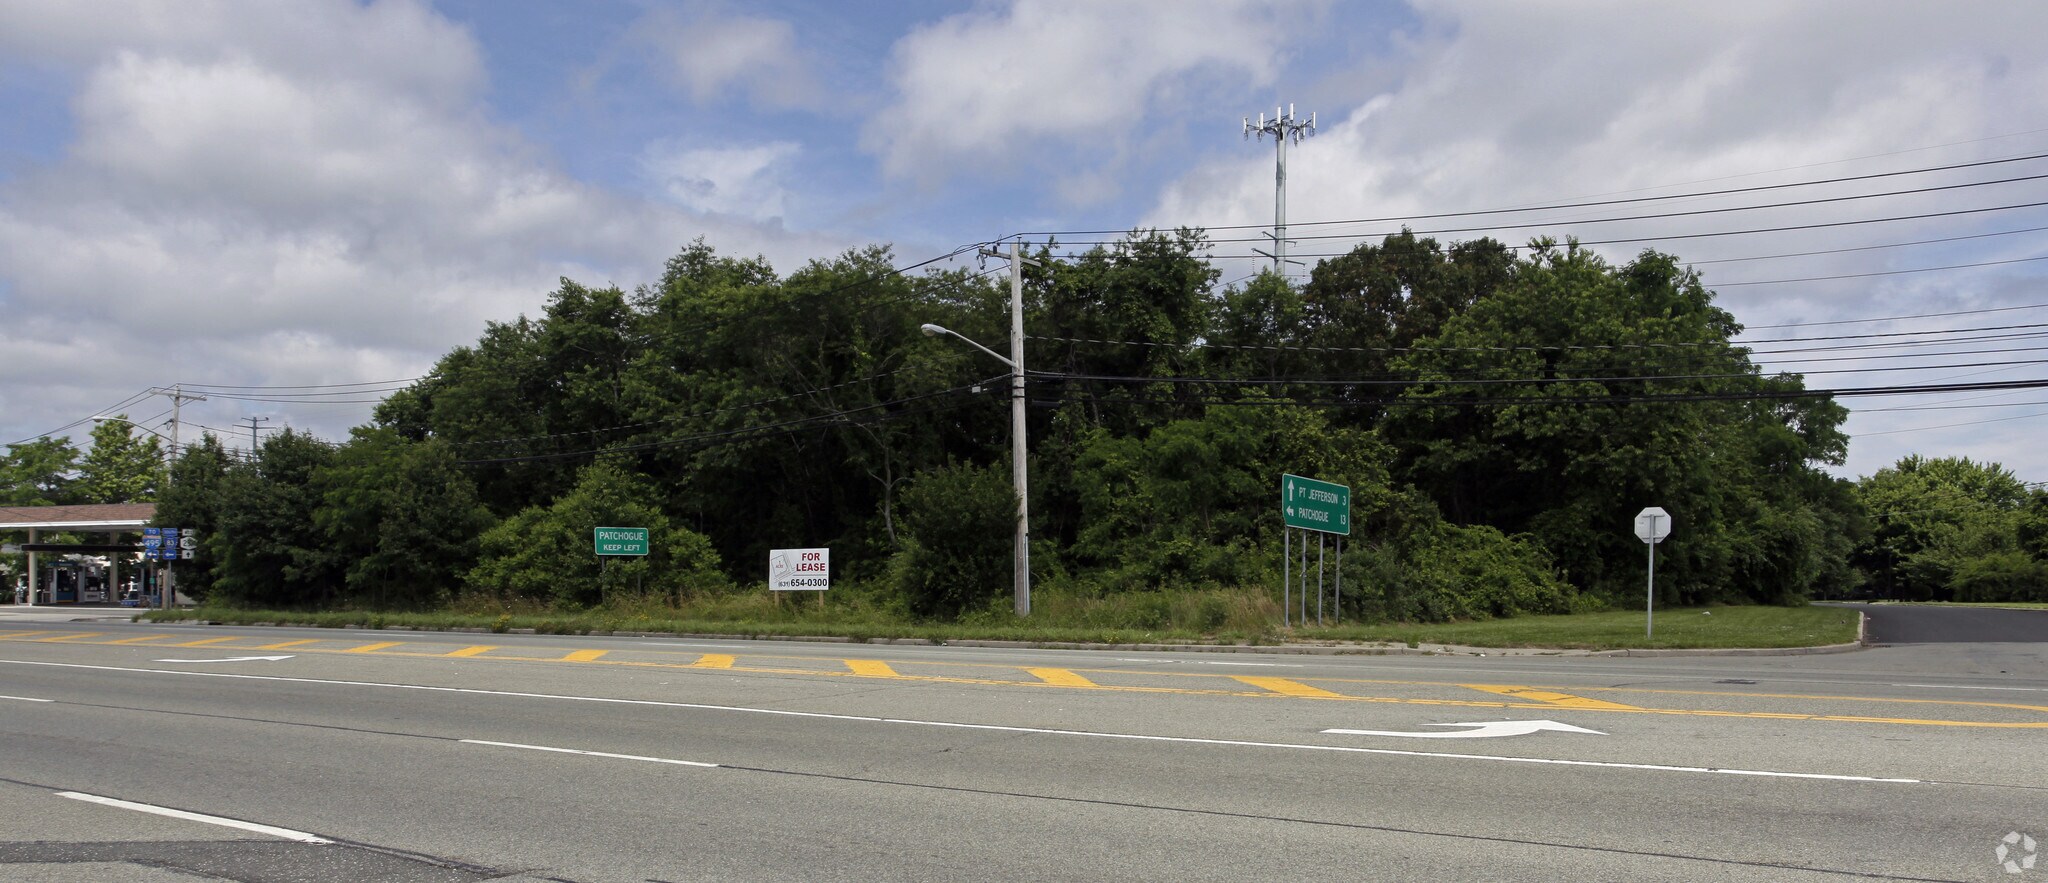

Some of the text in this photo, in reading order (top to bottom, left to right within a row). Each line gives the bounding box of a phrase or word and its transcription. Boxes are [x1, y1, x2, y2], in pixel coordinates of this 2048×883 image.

[1298, 486, 1347, 506] PT JEFFERSON 3
[1298, 507, 1347, 525] PATCHOGUE 13
[599, 531, 644, 541] PATCHOGUE
[144, 539, 160, 547] 495
[801, 552, 820, 561] FOR
[796, 562, 826, 572] LEASE
[790, 578, 828, 587] 654-0300
